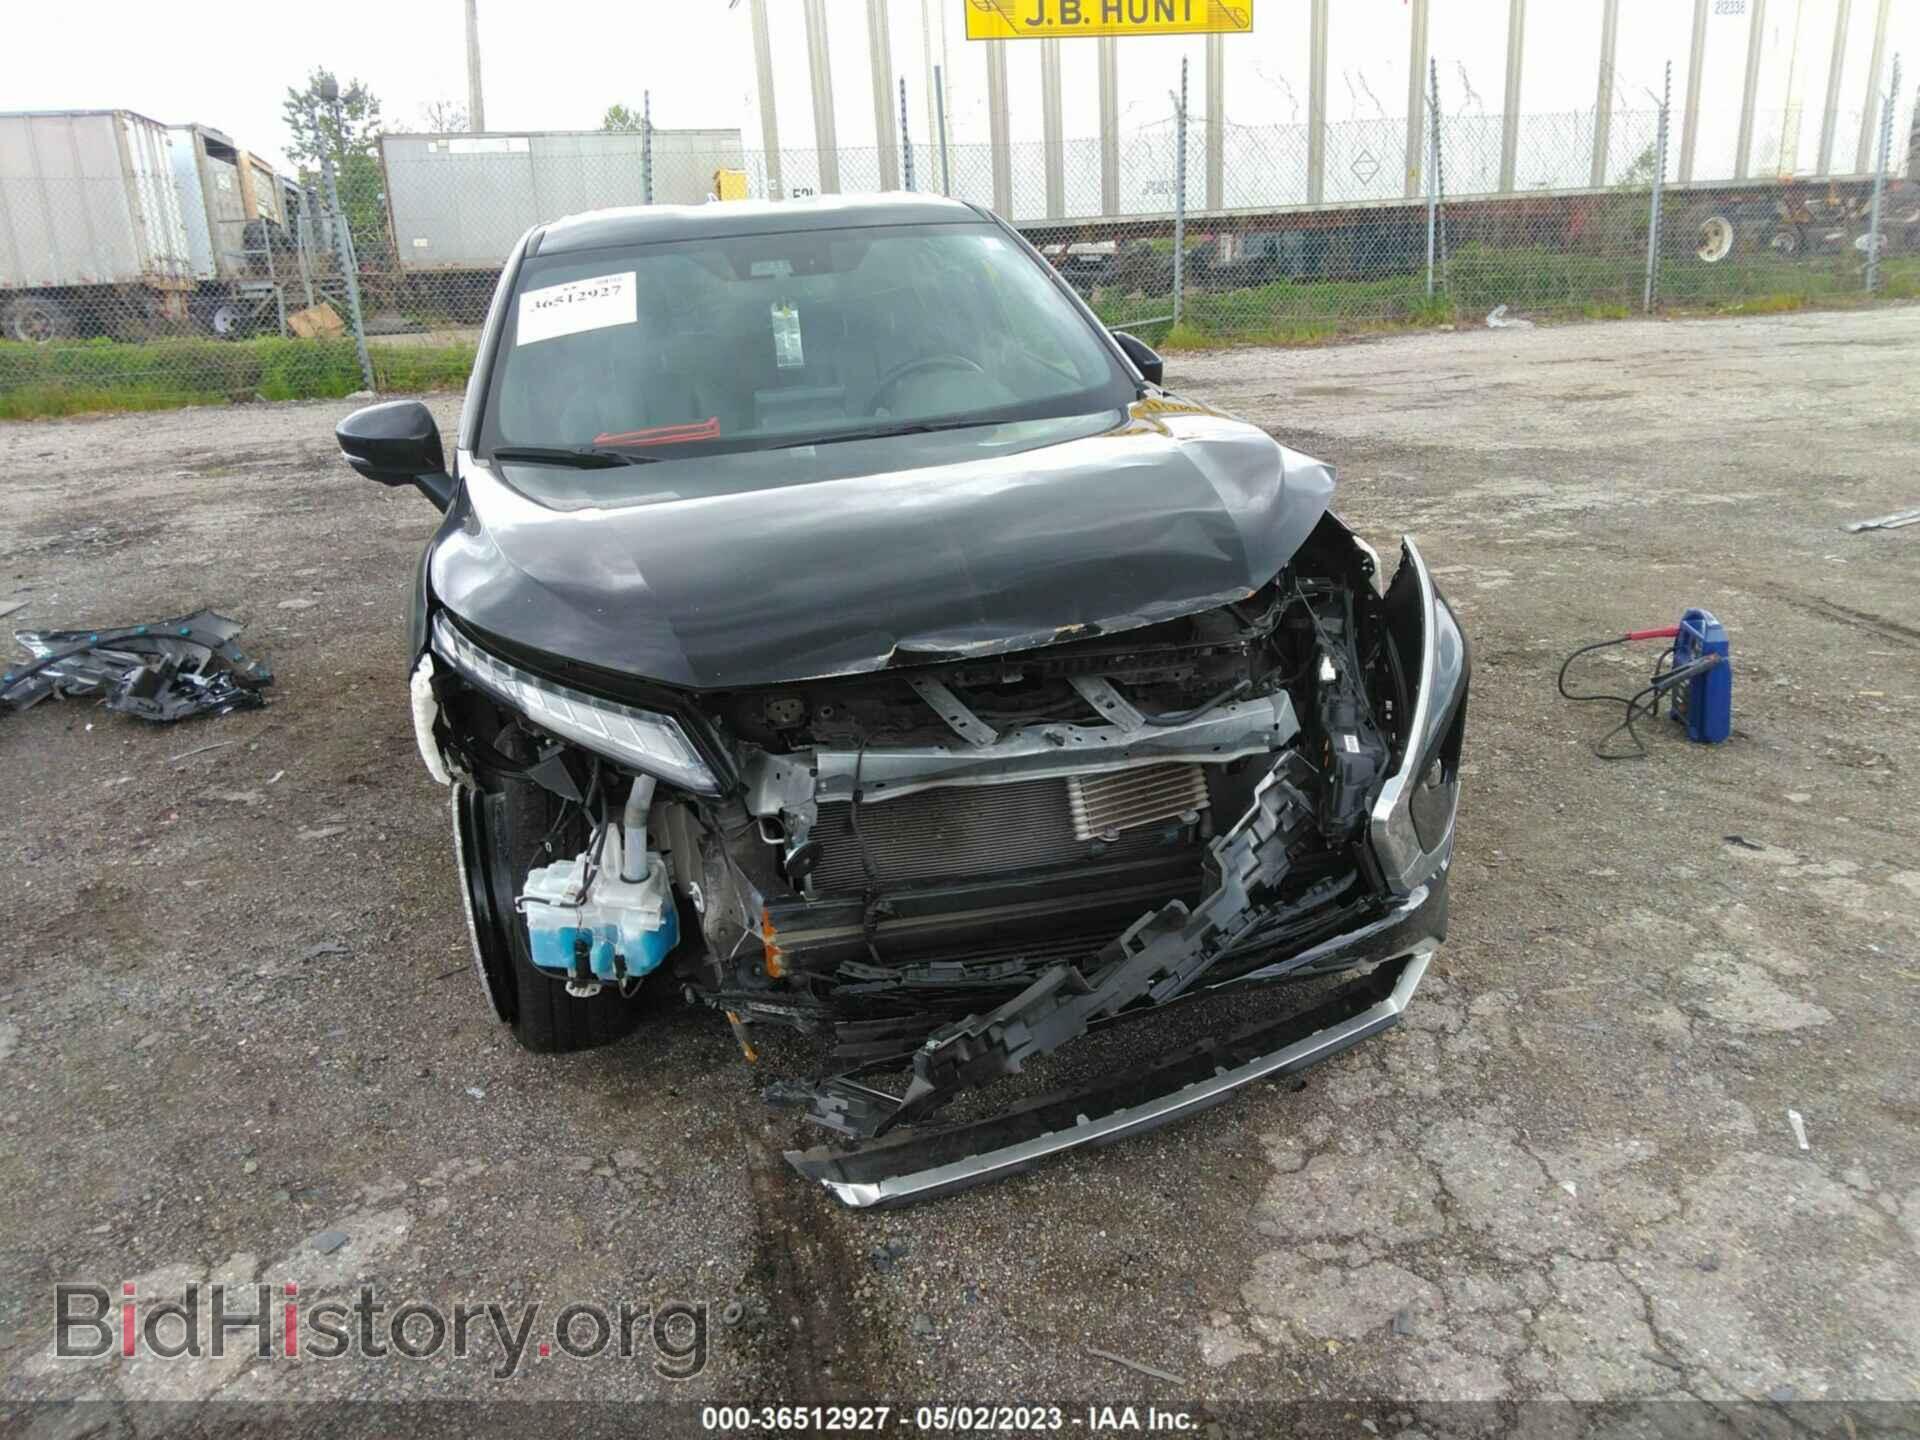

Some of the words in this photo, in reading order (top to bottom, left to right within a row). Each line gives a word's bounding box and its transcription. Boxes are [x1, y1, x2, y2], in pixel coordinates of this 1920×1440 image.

[1025, 0, 1090, 26] J.B.
[1101, 0, 1192, 24] HUNT
[530, 284, 622, 313] 36512927
